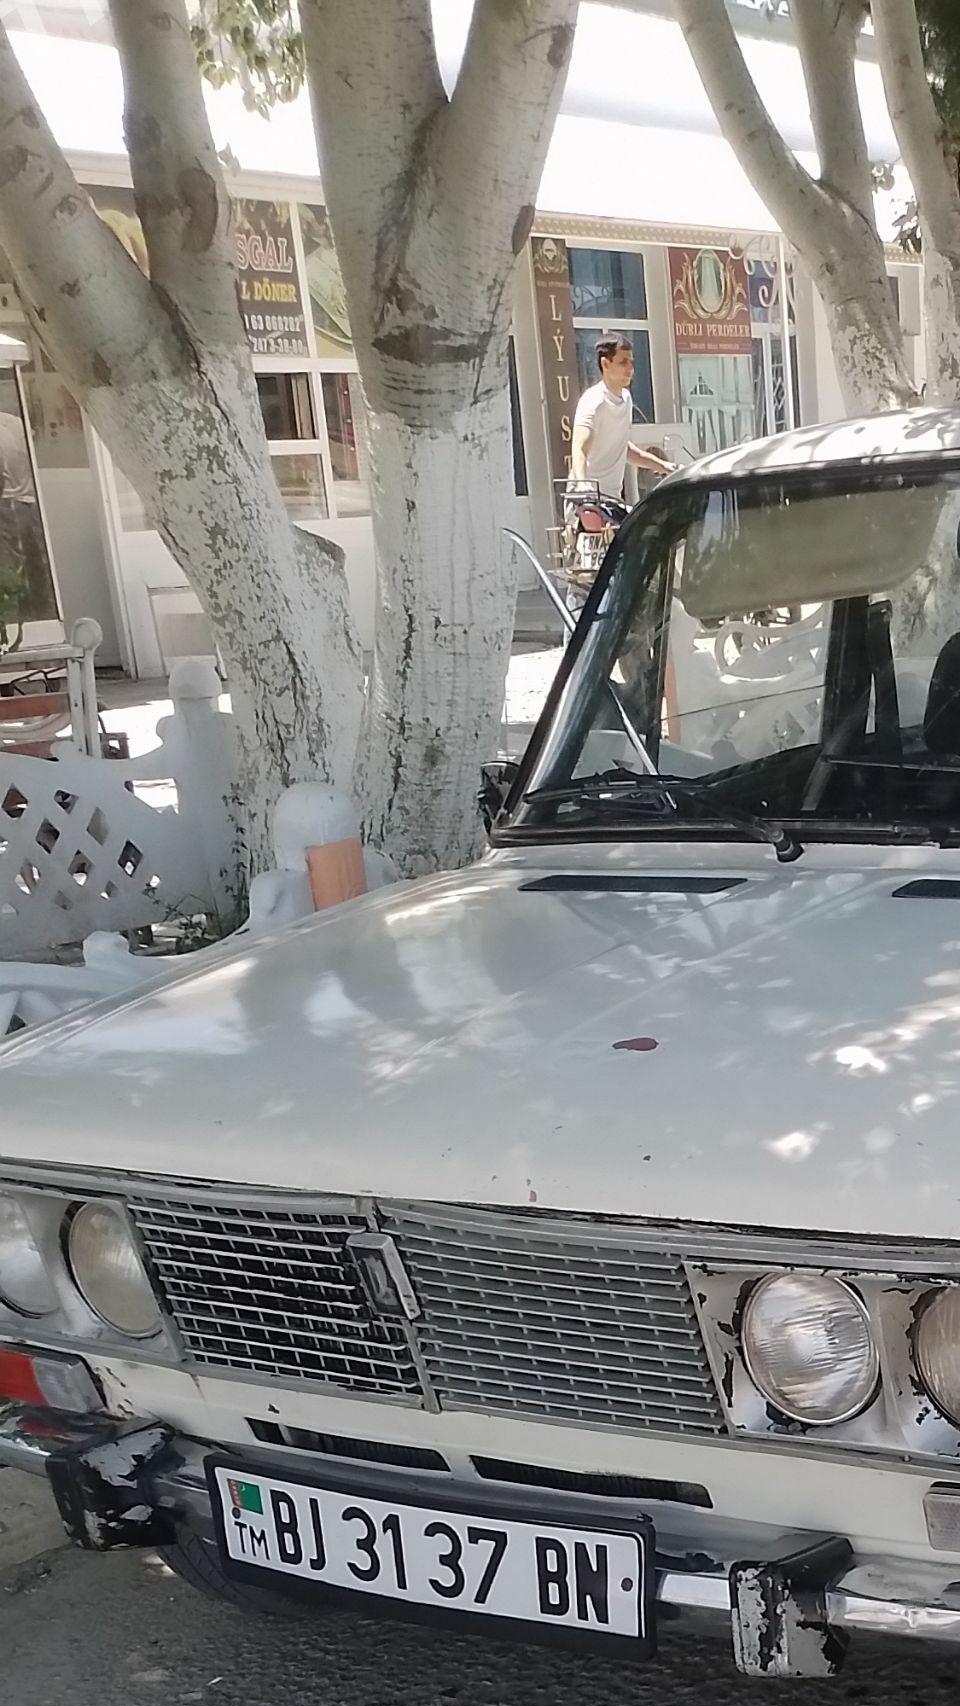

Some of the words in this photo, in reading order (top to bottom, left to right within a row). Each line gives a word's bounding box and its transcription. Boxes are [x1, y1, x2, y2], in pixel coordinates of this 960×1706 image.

[253, 277, 298, 303] DÖNER
[234, 1520, 271, 1561] TM
[270, 1489, 327, 1571] BJ
[341, 1506, 408, 1590] 31
[423, 1521, 508, 1604] 37
[534, 1536, 609, 1624] BN
